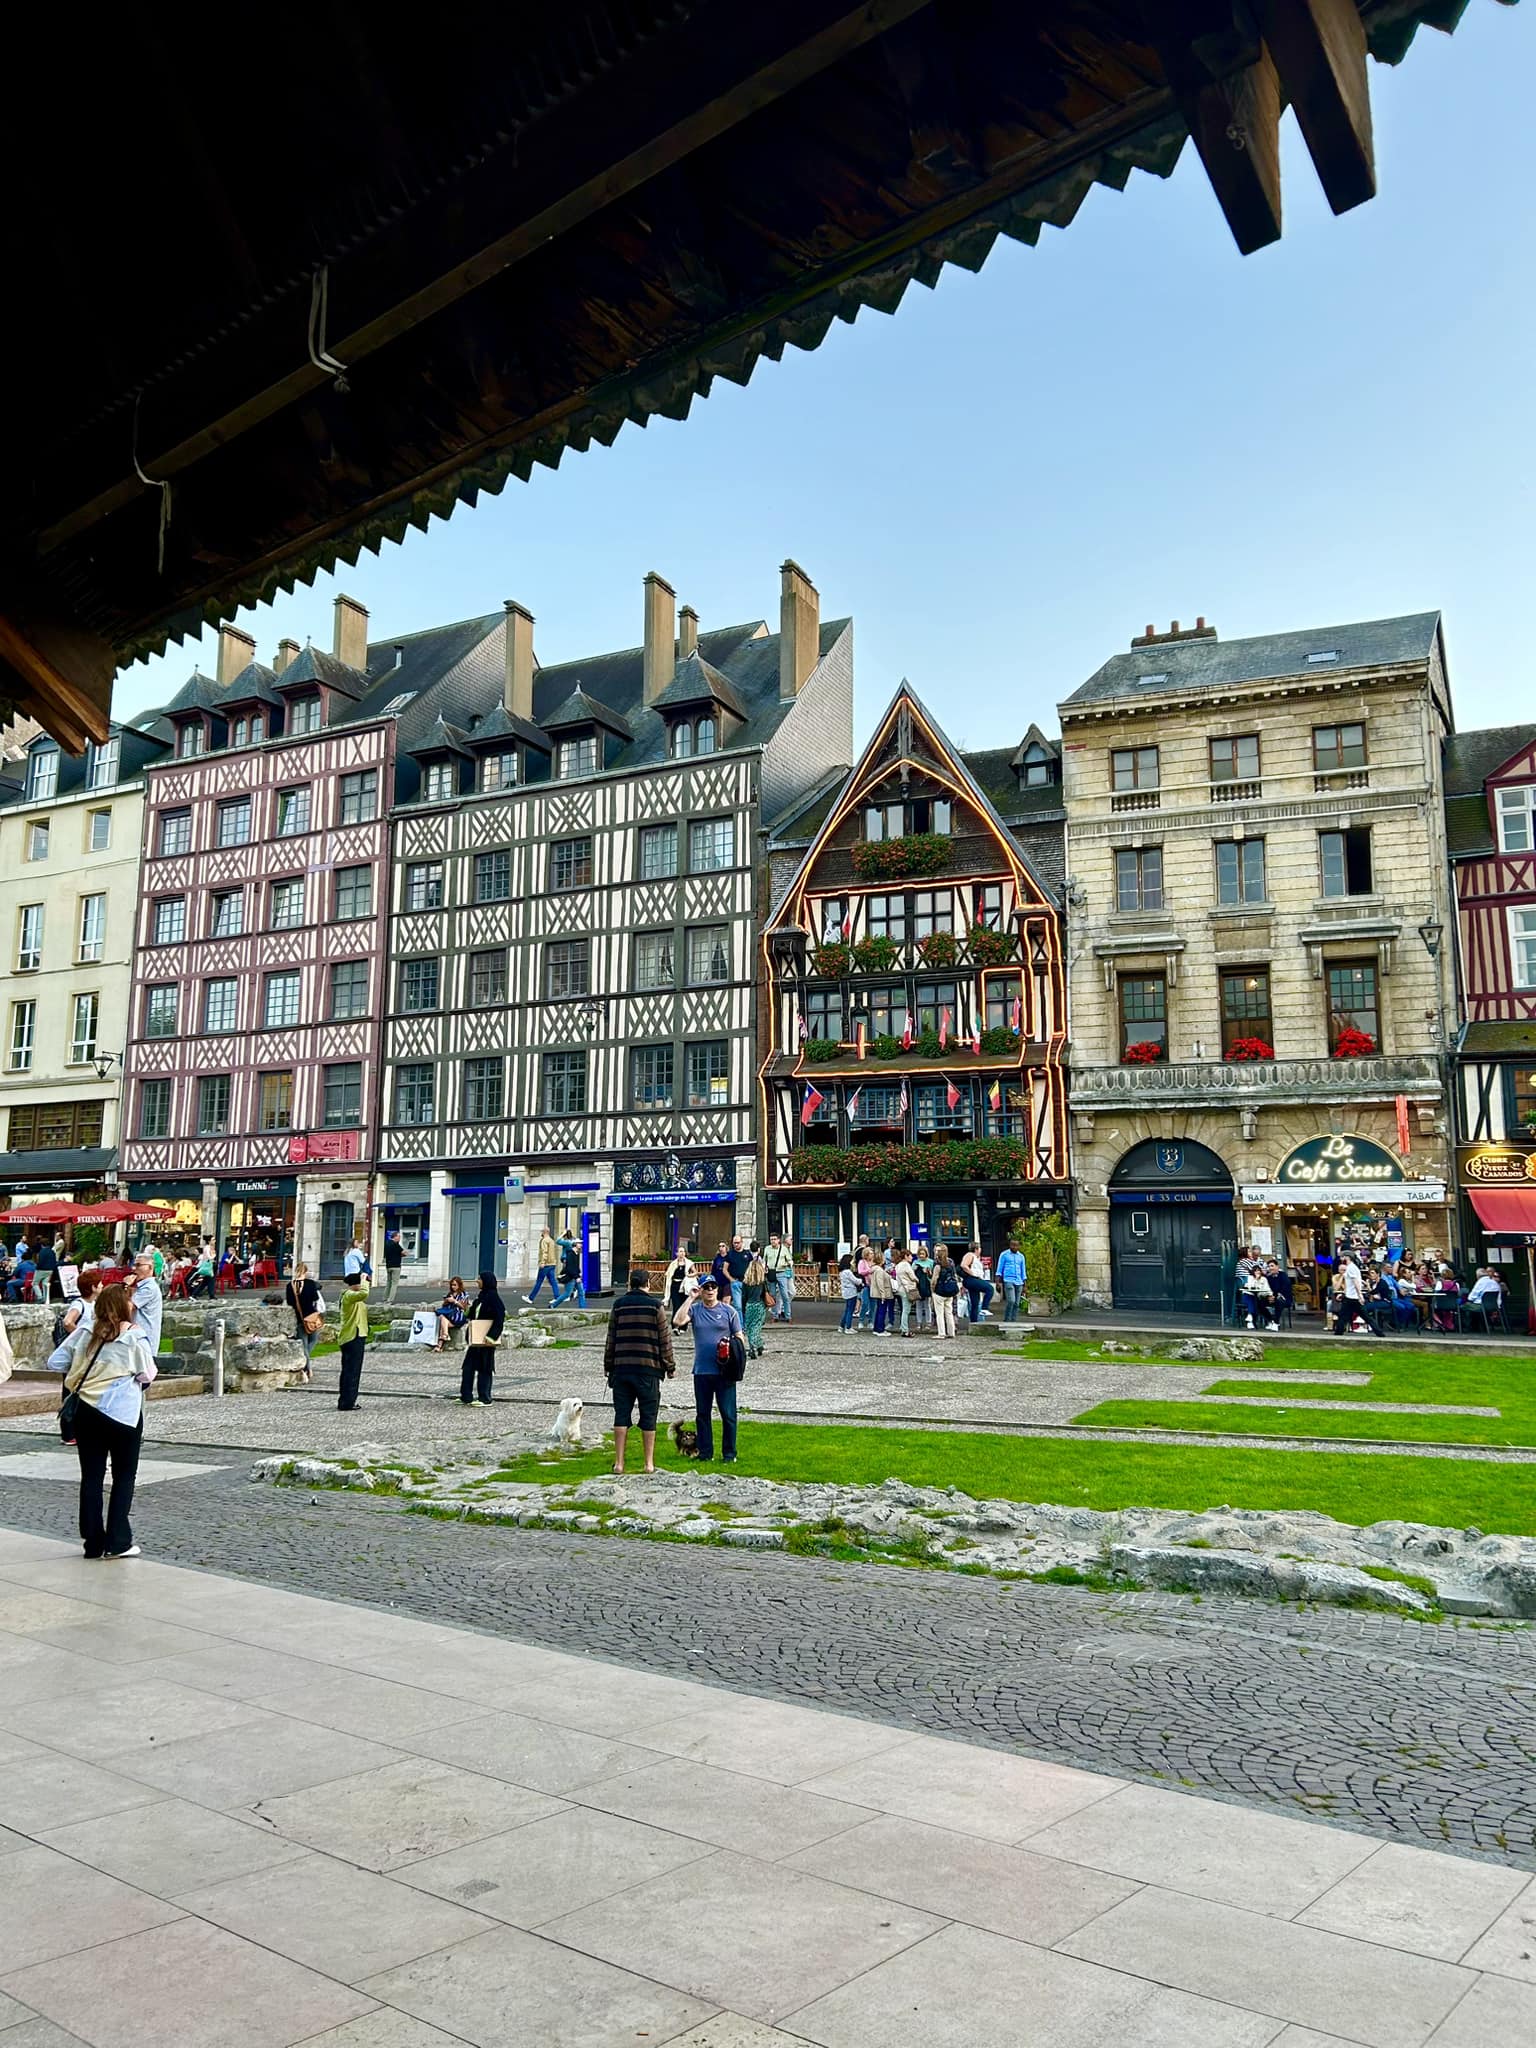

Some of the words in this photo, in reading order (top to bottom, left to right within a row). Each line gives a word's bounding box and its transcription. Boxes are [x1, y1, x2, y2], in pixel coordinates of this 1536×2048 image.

[1321, 1138, 1353, 1158] Le
[1162, 1148, 1179, 1161] 33
[1288, 1160, 1330, 1182] Café
[1482, 1170, 1524, 1178] CALVADOS
[1146, 1194, 1155, 1202] LE
[1248, 1193, 1265, 1202] BAR
[1407, 1192, 1439, 1200] TABAC
